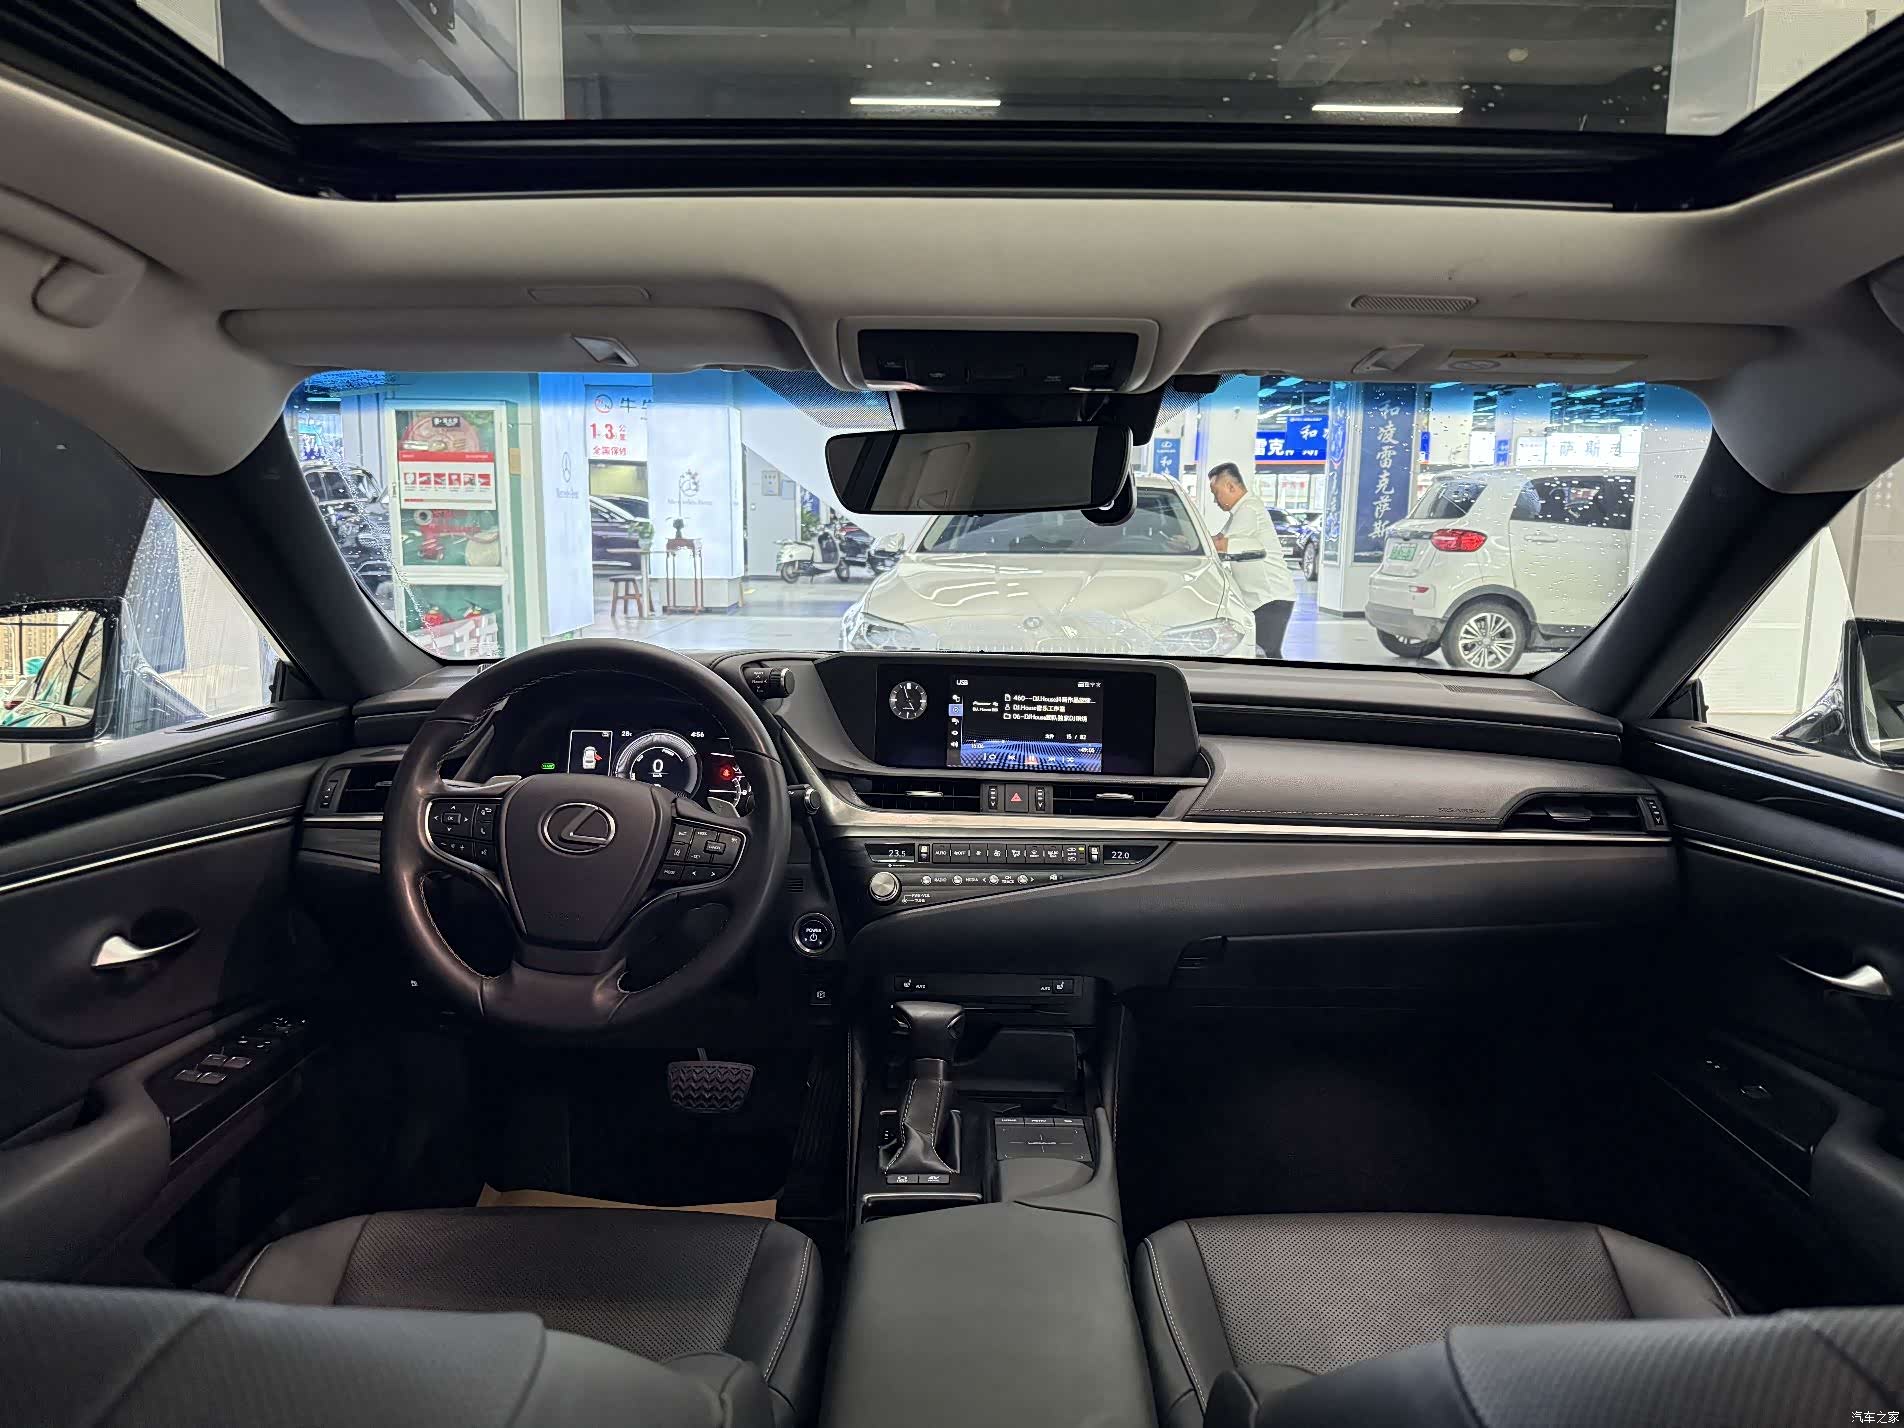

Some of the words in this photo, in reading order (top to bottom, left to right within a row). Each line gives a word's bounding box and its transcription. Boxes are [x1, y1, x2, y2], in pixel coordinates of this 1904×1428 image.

[1368, 400, 1401, 538] 和凌雷克萨斯
[652, 758, 664, 773] 0
[888, 849, 906, 858] 23.5
[1111, 851, 1130, 859] 22.0
